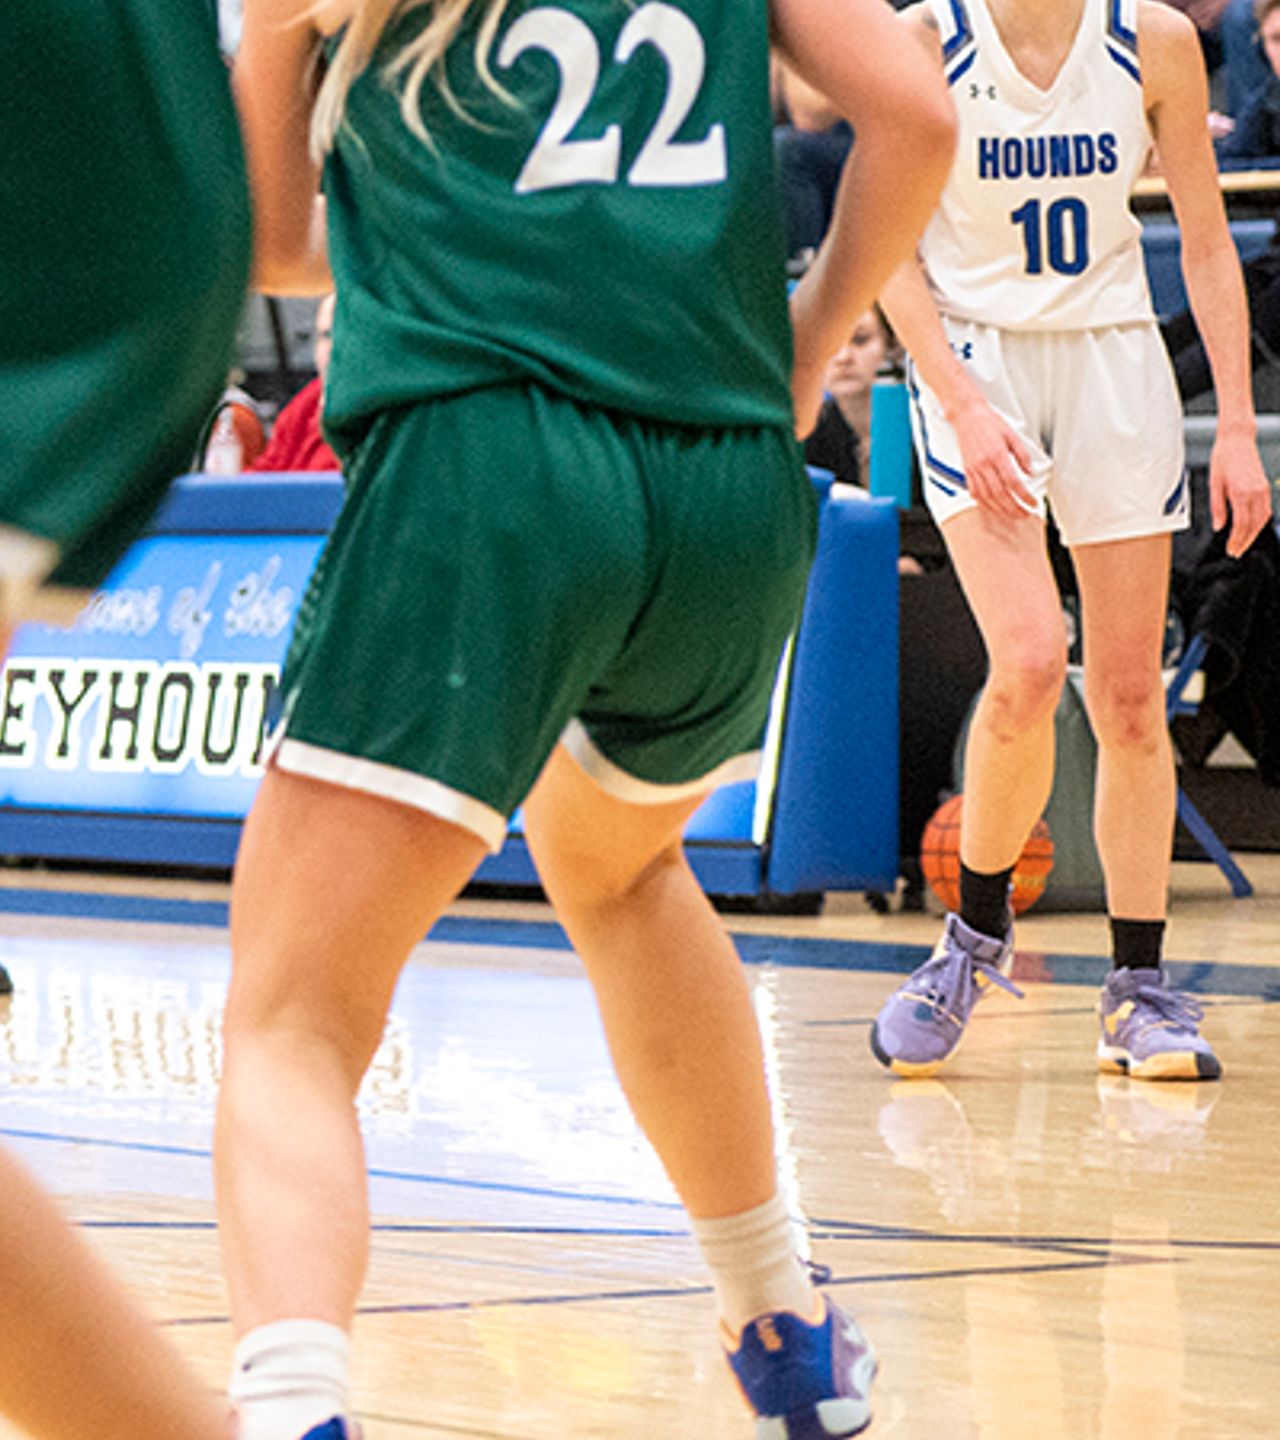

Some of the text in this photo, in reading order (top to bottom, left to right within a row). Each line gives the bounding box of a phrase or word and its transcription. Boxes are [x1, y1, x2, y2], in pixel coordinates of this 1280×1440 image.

[497, 0, 728, 194] 22
[976, 132, 1119, 180] HOUNDS
[1010, 196, 1091, 277] 10
[80, 586, 162, 637] ome
